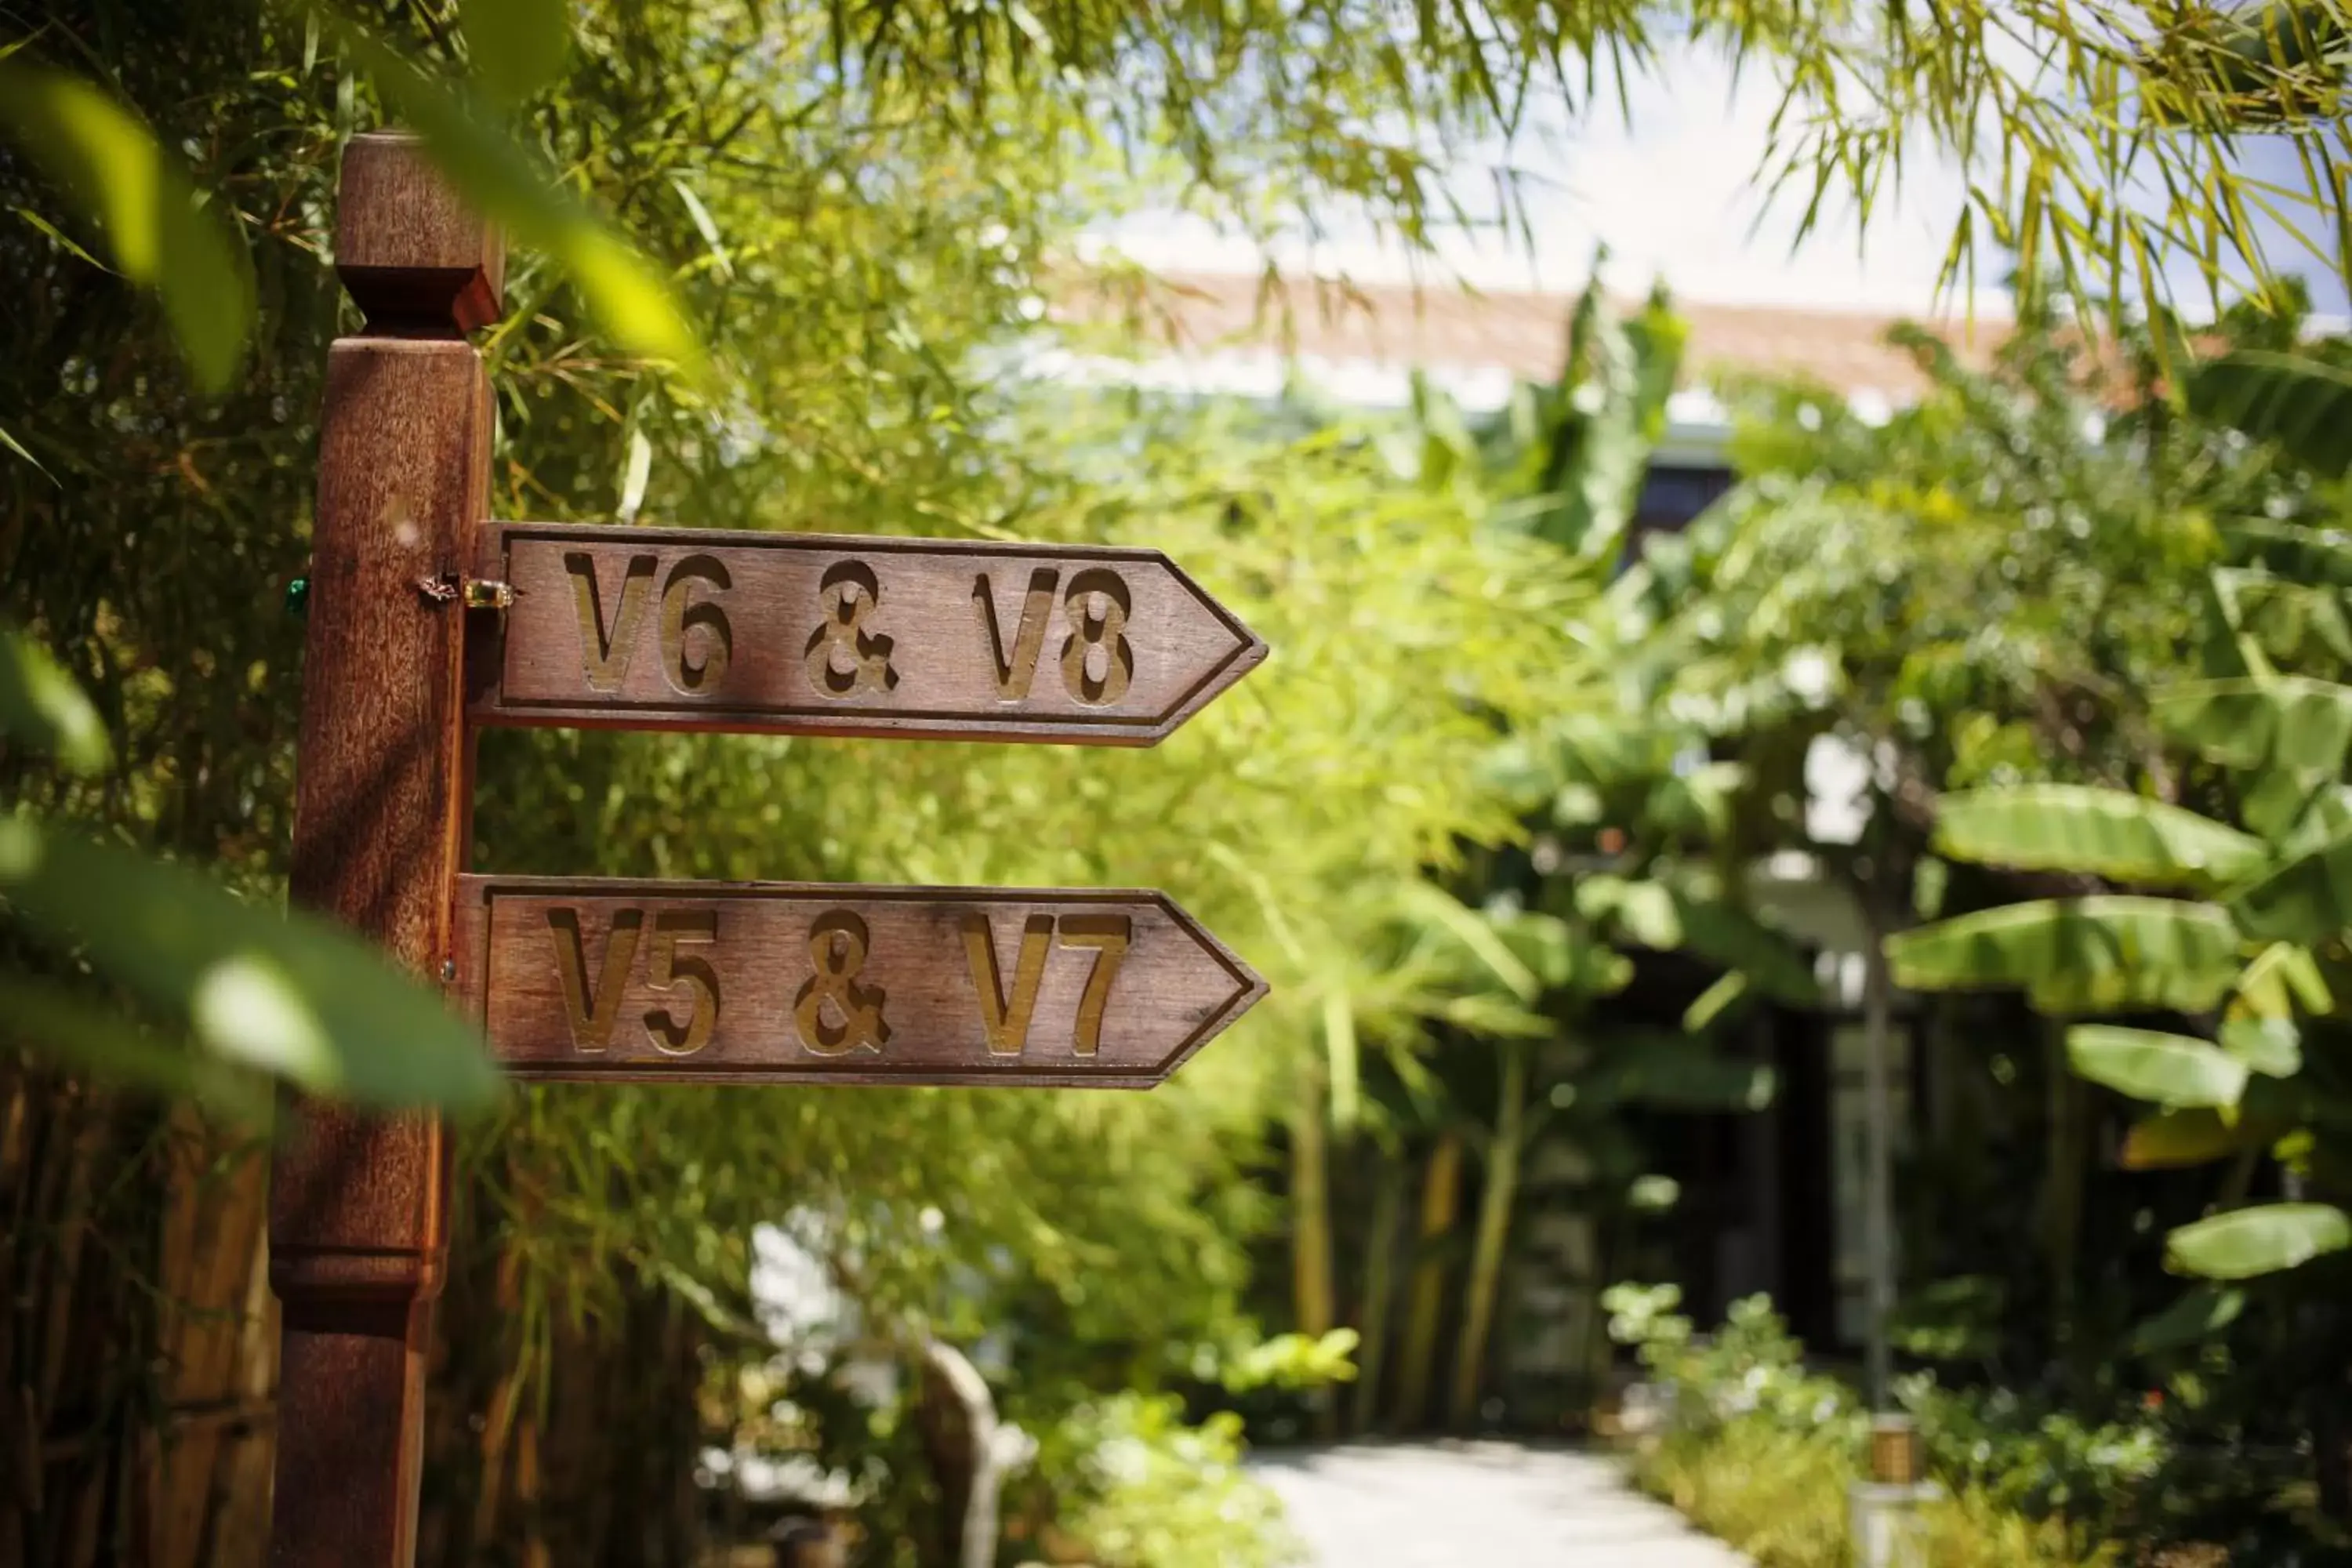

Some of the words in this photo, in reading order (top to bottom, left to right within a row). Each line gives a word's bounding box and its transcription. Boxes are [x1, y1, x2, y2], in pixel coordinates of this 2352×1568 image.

[563, 552, 733, 696] V6
[803, 558, 901, 699] &
[972, 567, 1134, 708] V8
[546, 908, 720, 1056] V5
[793, 909, 891, 1056] &
[959, 913, 1131, 1058] V7
